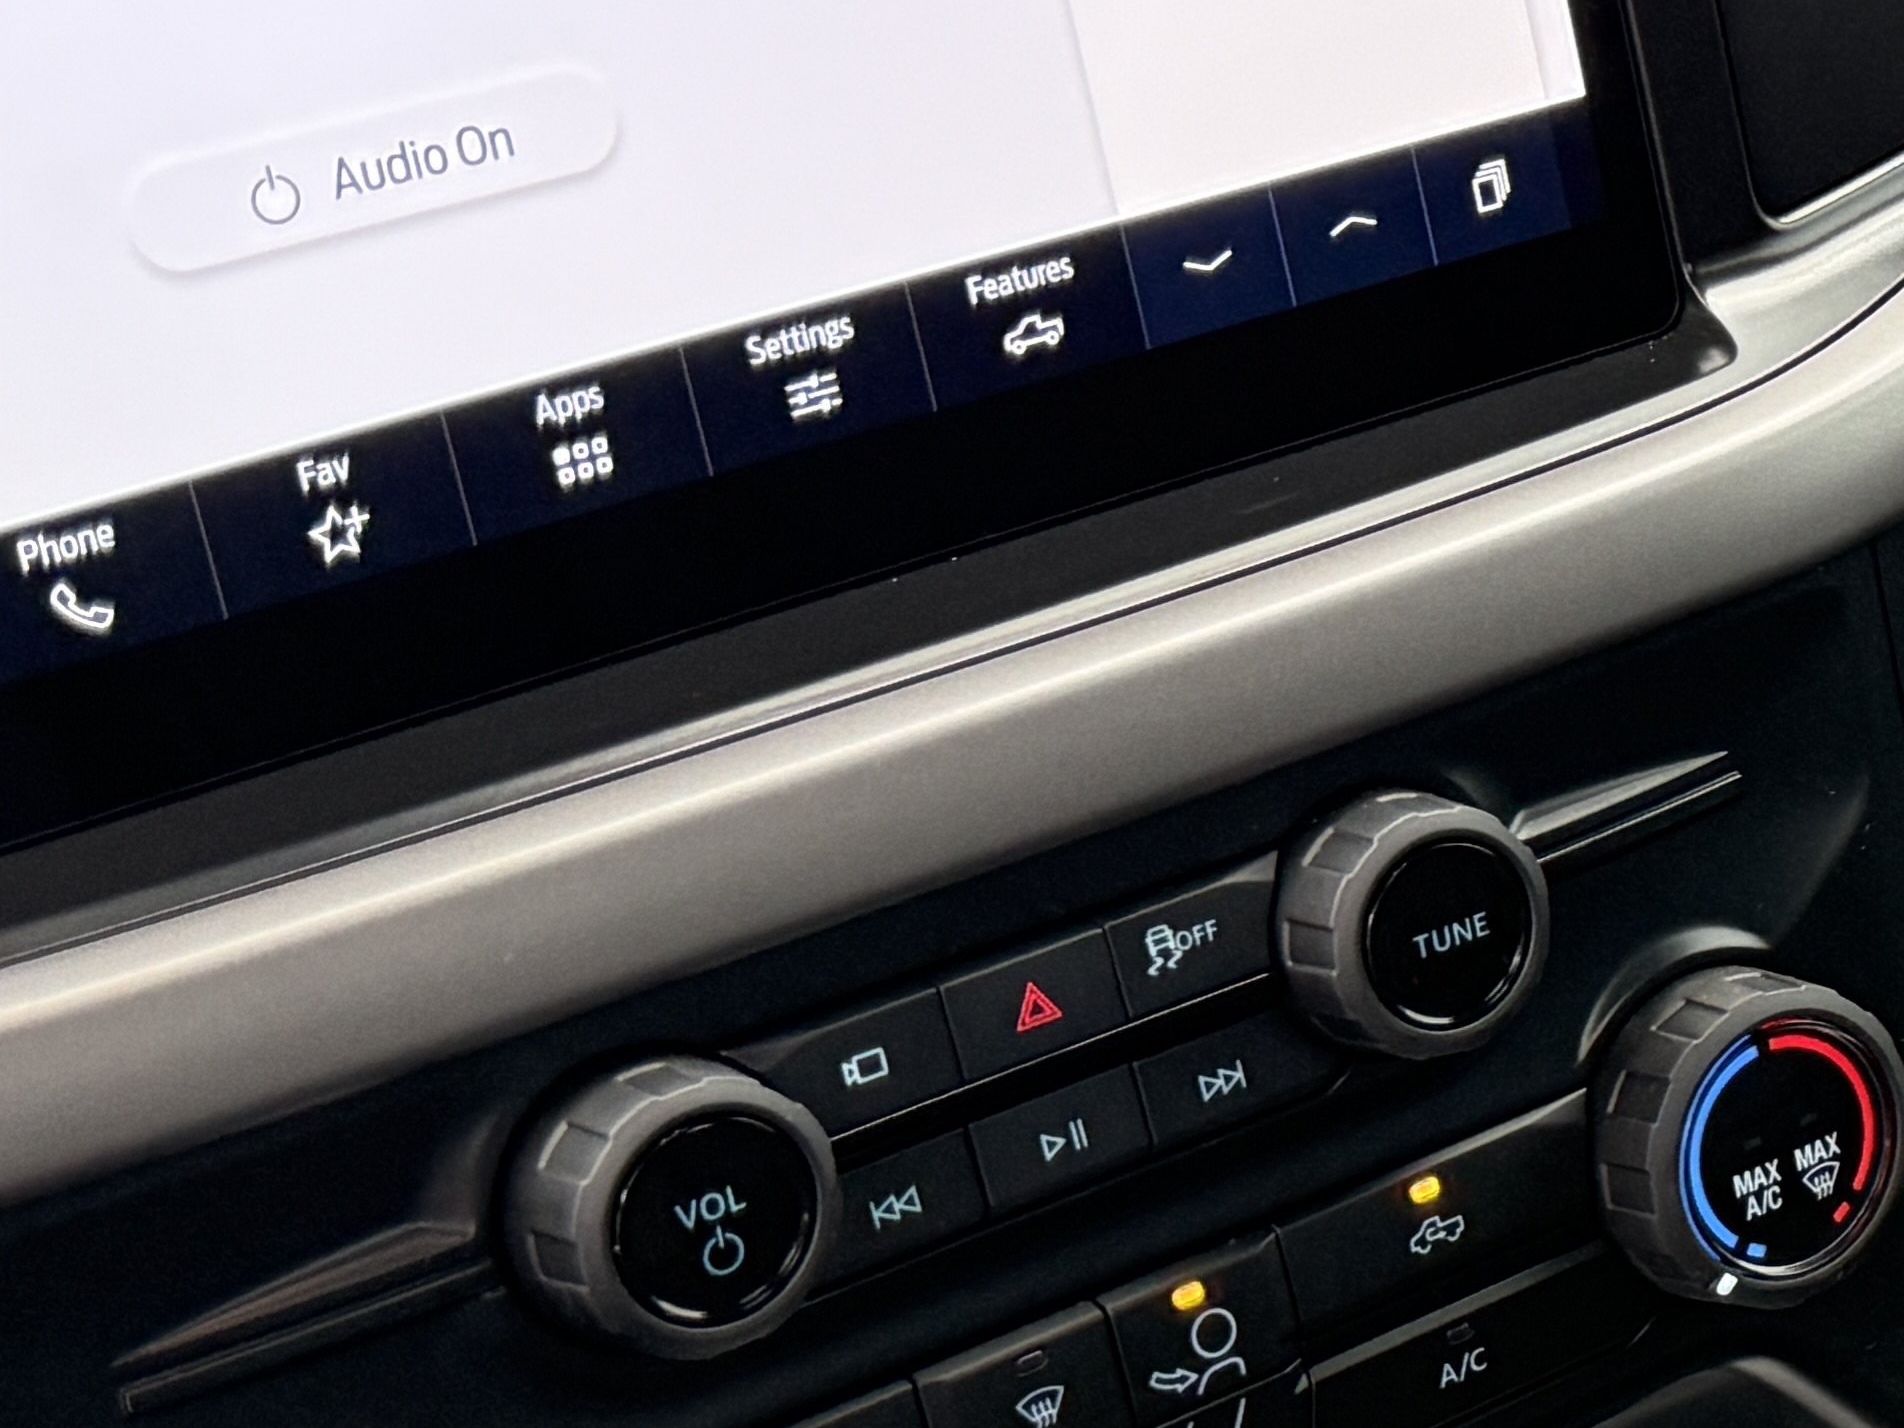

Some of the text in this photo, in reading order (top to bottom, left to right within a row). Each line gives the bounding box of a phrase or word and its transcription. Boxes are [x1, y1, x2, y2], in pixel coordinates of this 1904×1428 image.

[333, 124, 517, 201] Audio On
[964, 253, 1076, 307] Features
[743, 312, 856, 369] Settings
[534, 382, 606, 430] Apps
[296, 452, 350, 495] Fav
[16, 520, 116, 576] Phone
[1174, 918, 1220, 954] OFF
[1412, 911, 1492, 960] TUNE
[1793, 1131, 1841, 1171] MAX
[1732, 1158, 1782, 1199] MAX
[675, 1186, 746, 1231] VOL
[1746, 1185, 1783, 1221] A/C
[1440, 1347, 1488, 1388] A/C
